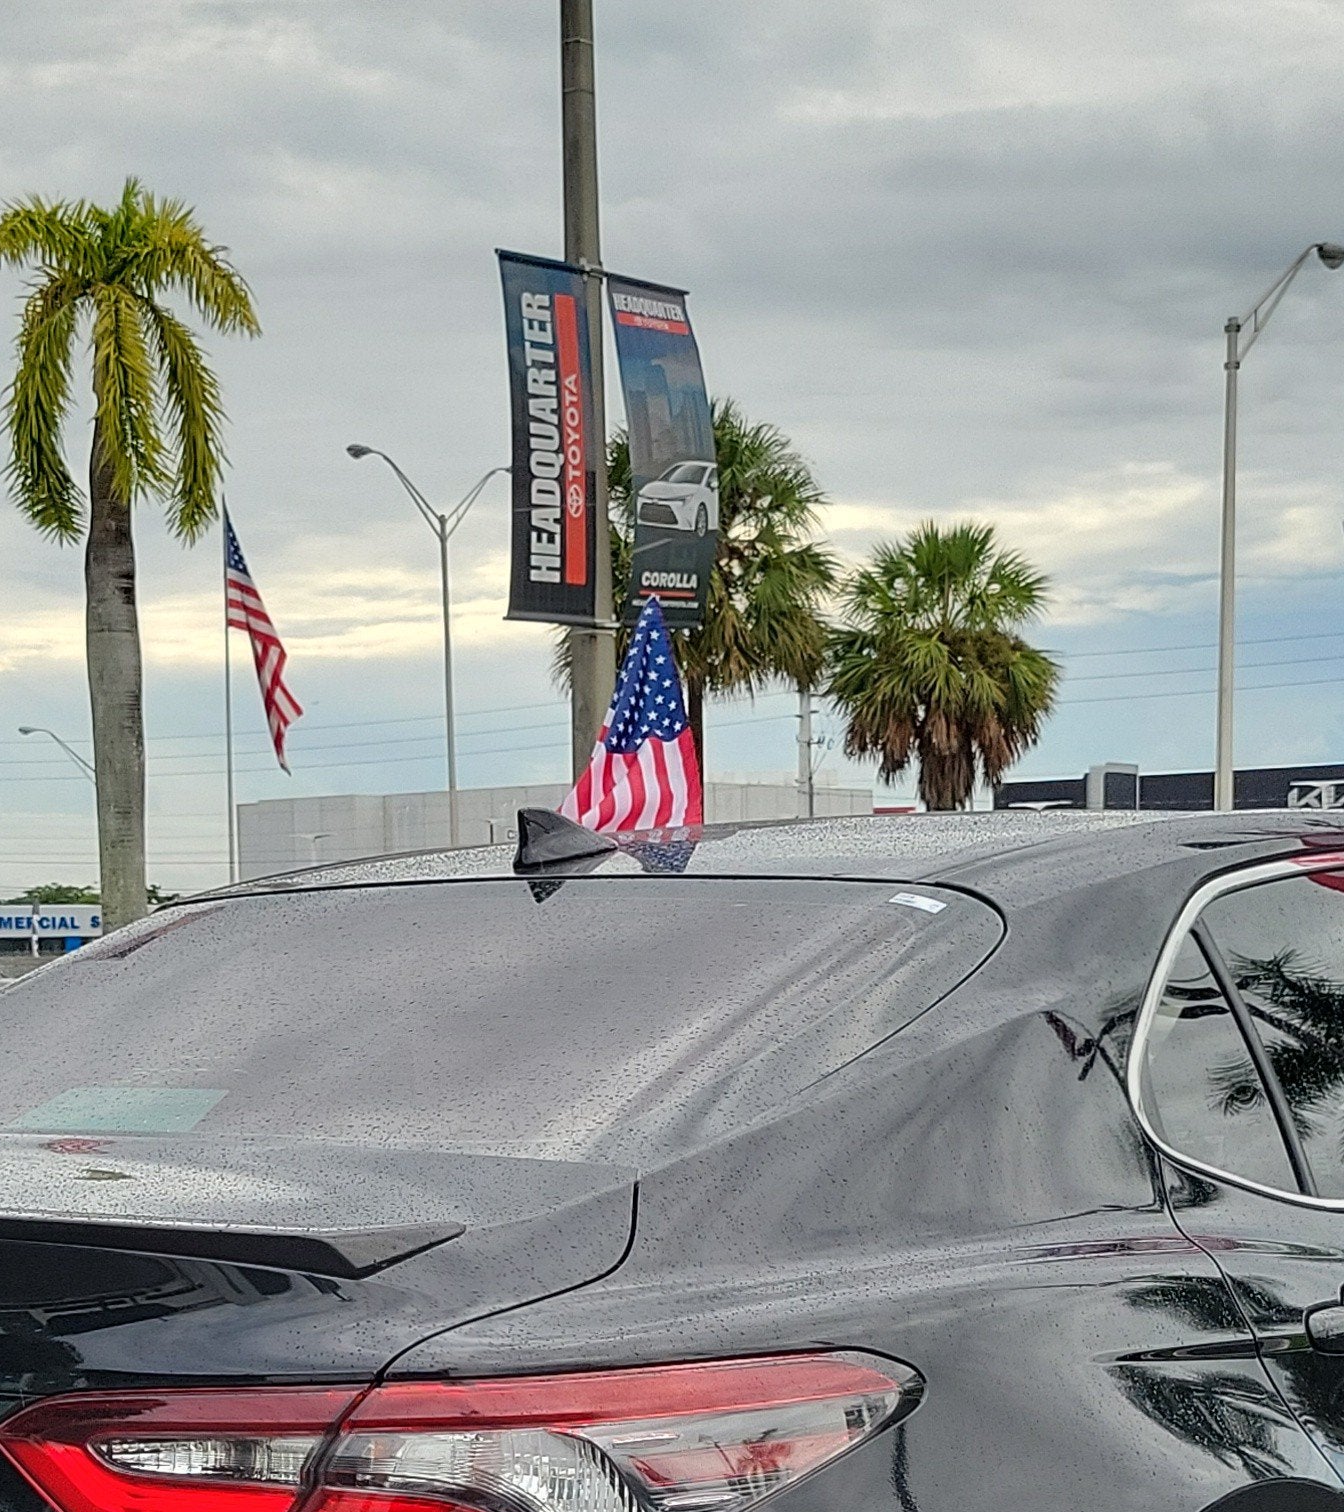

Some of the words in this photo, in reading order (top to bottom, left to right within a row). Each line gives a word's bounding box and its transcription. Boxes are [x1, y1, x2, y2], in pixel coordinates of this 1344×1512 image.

[521, 292, 564, 584] HEADQUARTER
[563, 374, 583, 479] TOYOTA
[641, 571, 698, 589] COROLLA
